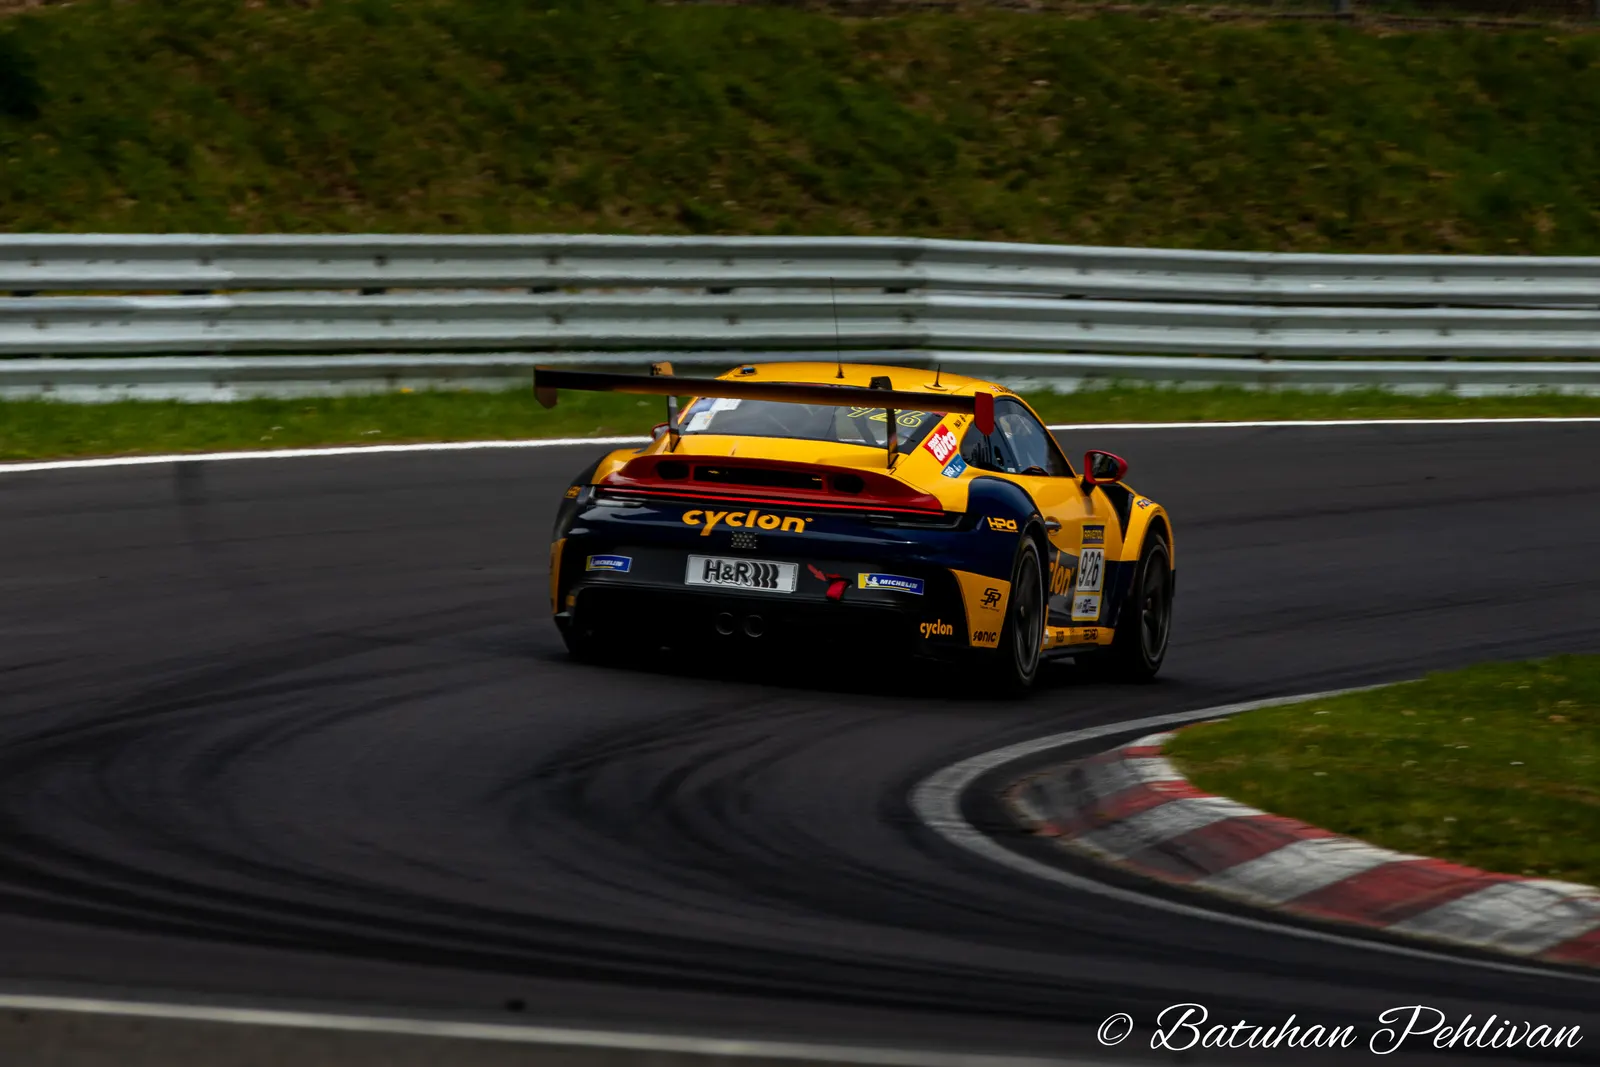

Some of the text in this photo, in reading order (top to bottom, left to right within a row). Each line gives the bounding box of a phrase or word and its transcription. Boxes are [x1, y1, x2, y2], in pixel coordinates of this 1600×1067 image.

[933, 431, 957, 461] auto
[682, 509, 806, 537] cyclon
[703, 559, 753, 586] H&R
[1078, 552, 1101, 587] 926
[878, 578, 919, 590] MICHELIN
[919, 619, 954, 639] cyclon
